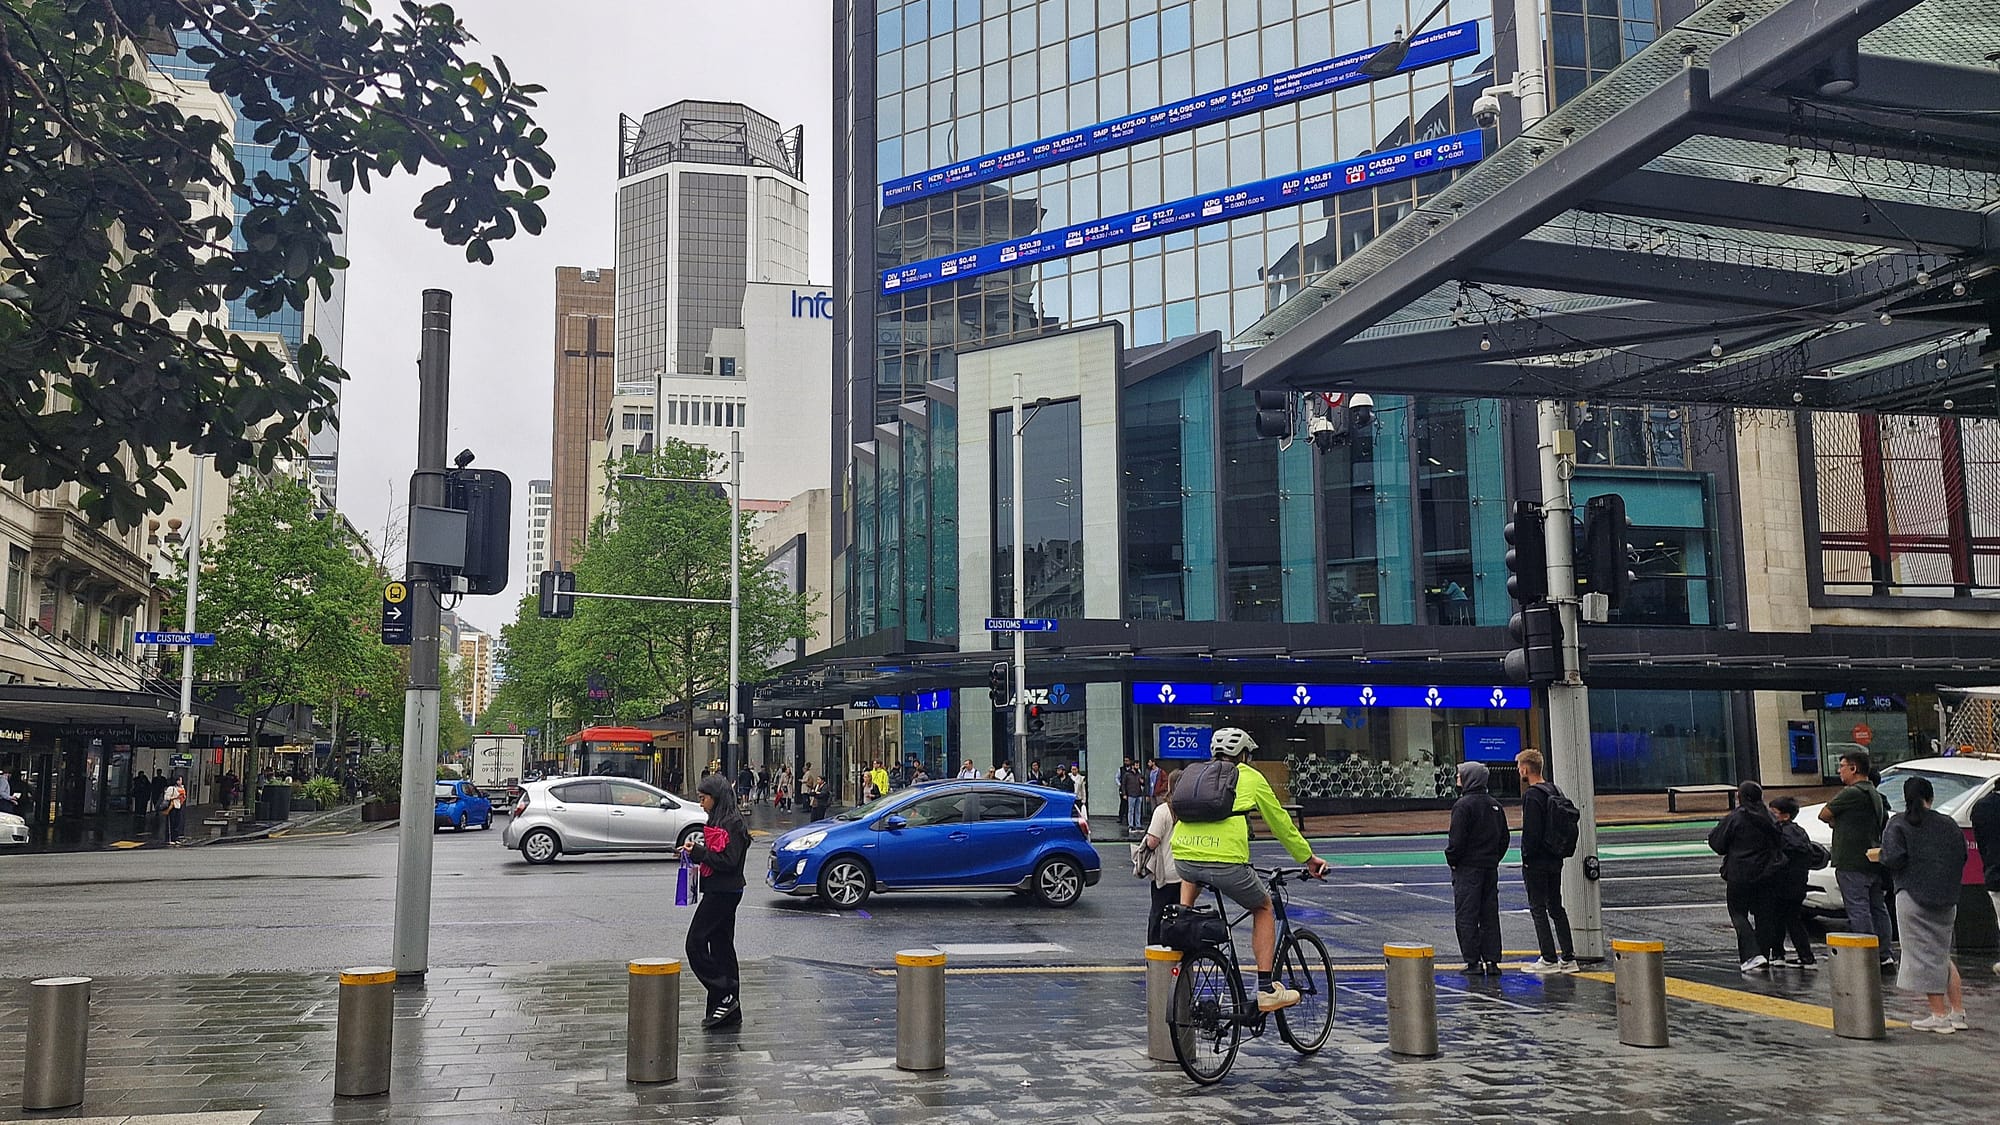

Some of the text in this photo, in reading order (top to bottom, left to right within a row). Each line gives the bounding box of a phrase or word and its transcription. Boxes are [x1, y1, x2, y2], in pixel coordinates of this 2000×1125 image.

[1274, 77, 1287, 85] How
[1288, 67, 1322, 81] Woolworths
[1323, 63, 1335, 71] and
[1335, 56, 1359, 69] ministry
[1429, 32, 1447, 42] strict
[1447, 28, 1463, 38] flour
[1274, 80, 1300, 92] dust limit
[1274, 89, 1295, 98] Tuesday
[1296, 85, 1302, 93] 27
[1303, 80, 1324, 91] October
[1210, 83, 1268, 106] SMP $4,125.00
[1232, 96, 1254, 107] Jan 2027
[1150, 101, 1206, 122] SMP $4,095.00
[1093, 117, 1147, 138] SMP $4,075.00
[1032, 134, 1083, 155] NZ50 13,630.71
[1414, 141, 1462, 159] EUR €051
[979, 159, 996, 169] NZ20
[1346, 154, 1407, 175] CAD CA$0.80
[1282, 171, 1332, 190] AUD A$0.81
[885, 184, 912, 197] REFINITIV
[1204, 192, 1247, 208] KPG $0.90
[1135, 209, 1174, 224] IFT $12.17
[1067, 224, 1109, 240] FPH $48.34
[941, 254, 977, 269] DOW $0.49
[887, 268, 917, 281] DIV $1.27
[792, 289, 833, 319] Info
[988, 619, 1021, 629] CUSTOMS
[156, 634, 191, 643] CUSTOMS
[1846, 697, 1859, 706] ANZ
[785, 709, 824, 718] GRAFF
[1295, 707, 1342, 725] ANZ
[753, 718, 772, 728] Dior
[1168, 736, 1198, 749] 25%
